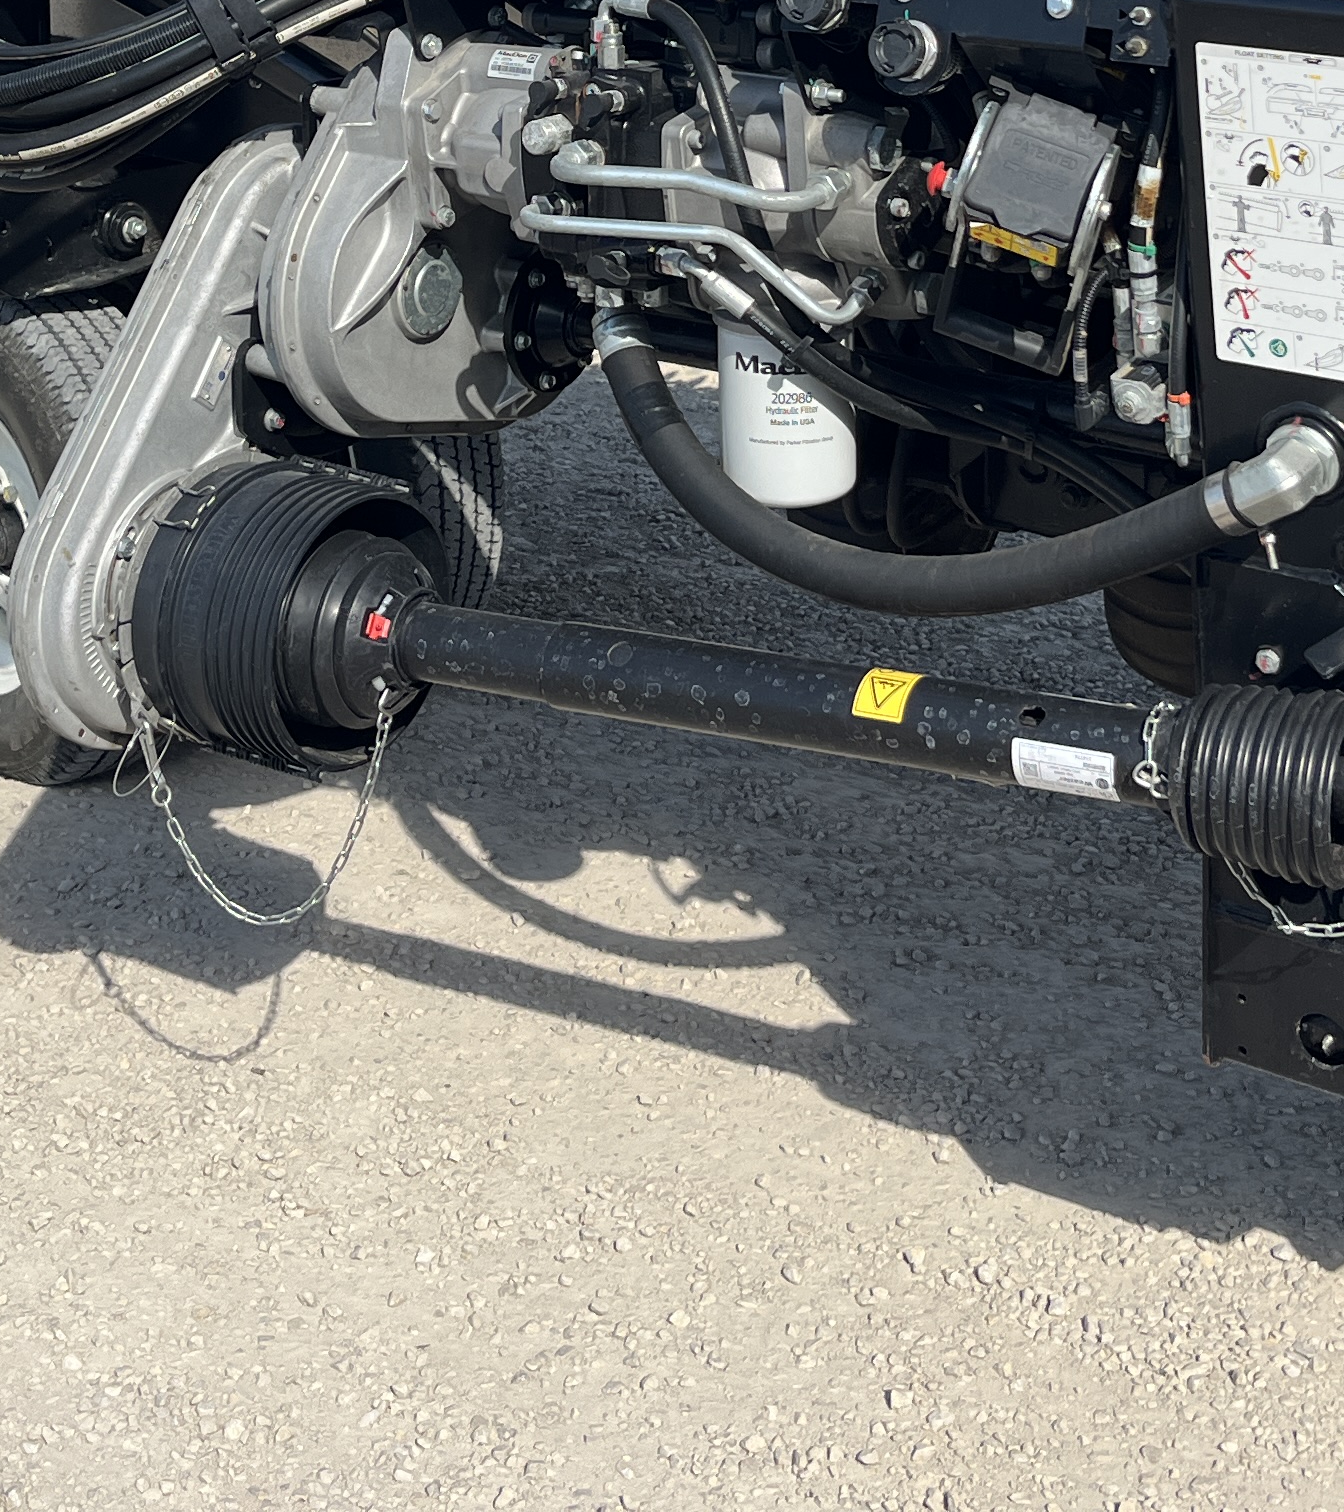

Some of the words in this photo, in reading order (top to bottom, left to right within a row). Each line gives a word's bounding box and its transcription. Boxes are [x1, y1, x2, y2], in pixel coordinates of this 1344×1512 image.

[1009, 138, 1078, 170] PATENTED
[766, 406, 798, 415] Hydraulic
[800, 405, 818, 413] Filter
